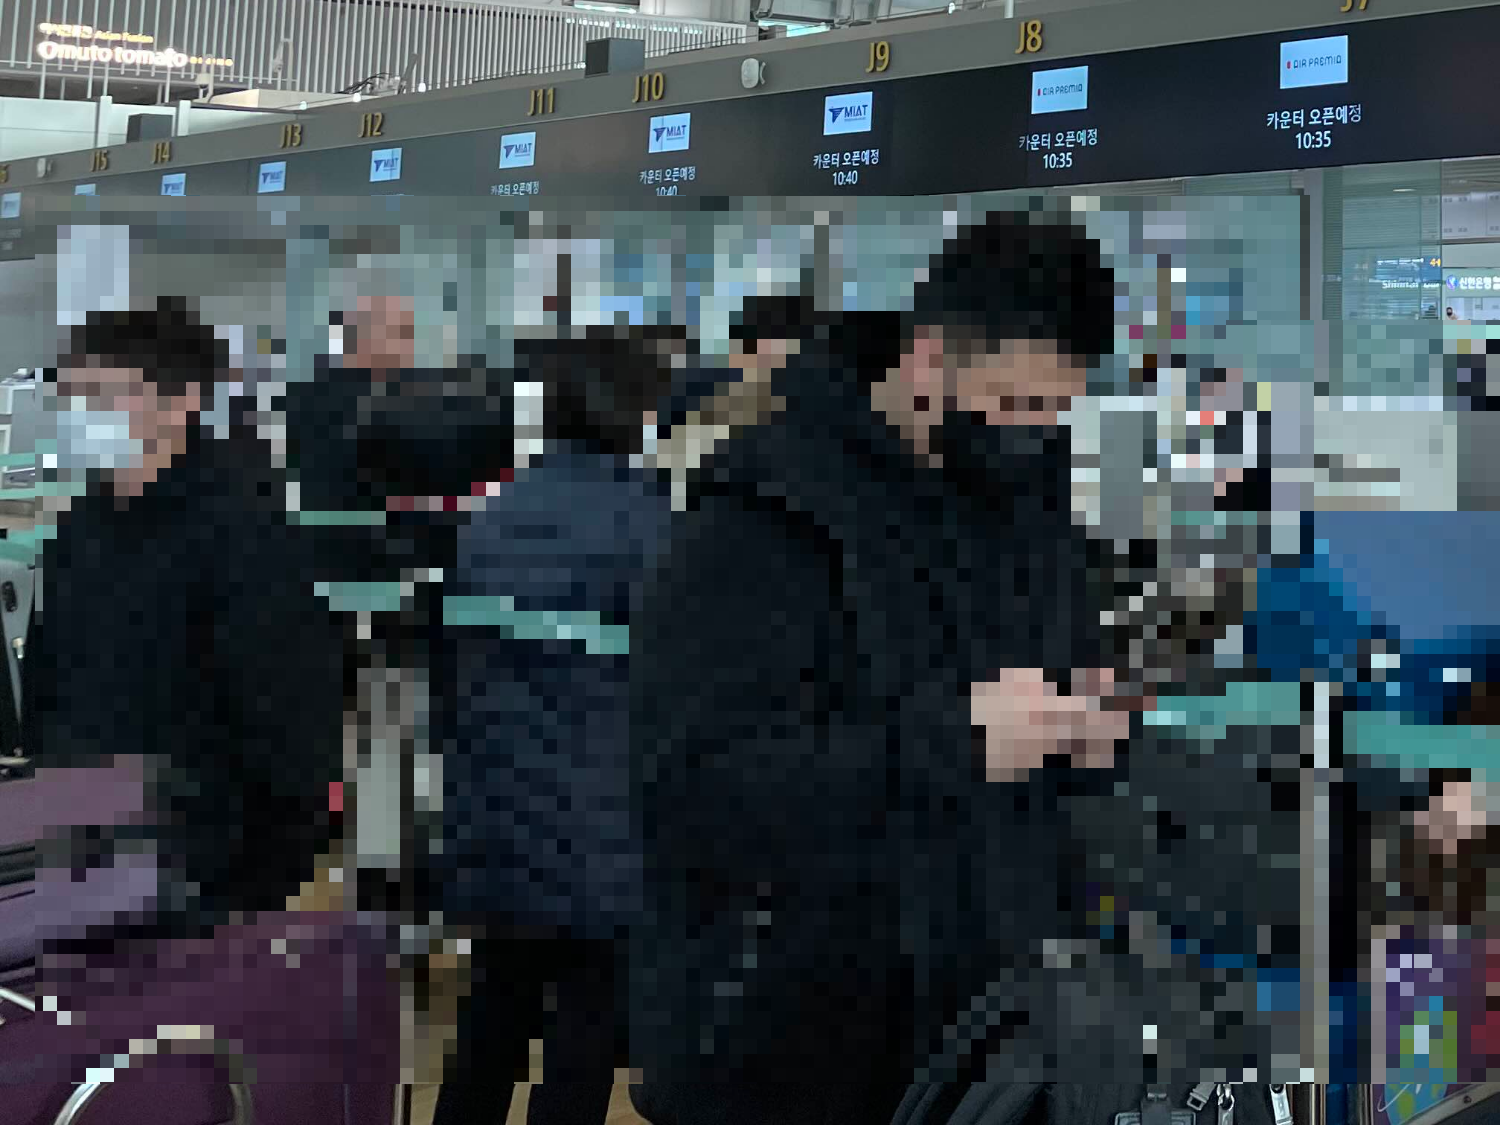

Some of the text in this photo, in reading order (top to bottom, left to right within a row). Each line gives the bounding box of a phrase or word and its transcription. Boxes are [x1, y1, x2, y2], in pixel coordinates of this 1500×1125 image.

[1015, 19, 1043, 54] J8
[865, 40, 890, 73] J9
[1293, 54, 1342, 68] AIR PREMIA
[632, 72, 665, 104] J10
[528, 87, 556, 116] J11
[844, 104, 868, 118] MIAT
[358, 112, 384, 138] J12
[1267, 103, 1362, 129] 카운터 오픈예정
[280, 124, 302, 148] J13
[666, 124, 686, 138] MIAT
[1018, 127, 1098, 151] 카운터 오픈예정
[1295, 130, 1332, 149] 10:35
[90, 149, 109, 172] J15
[153, 141, 172, 164] J14
[812, 148, 880, 169] 카운터 오픈예정
[1042, 151, 1073, 169] 10:35
[639, 165, 696, 184] 카운터 오픈예정
[832, 170, 858, 186] 10:40
